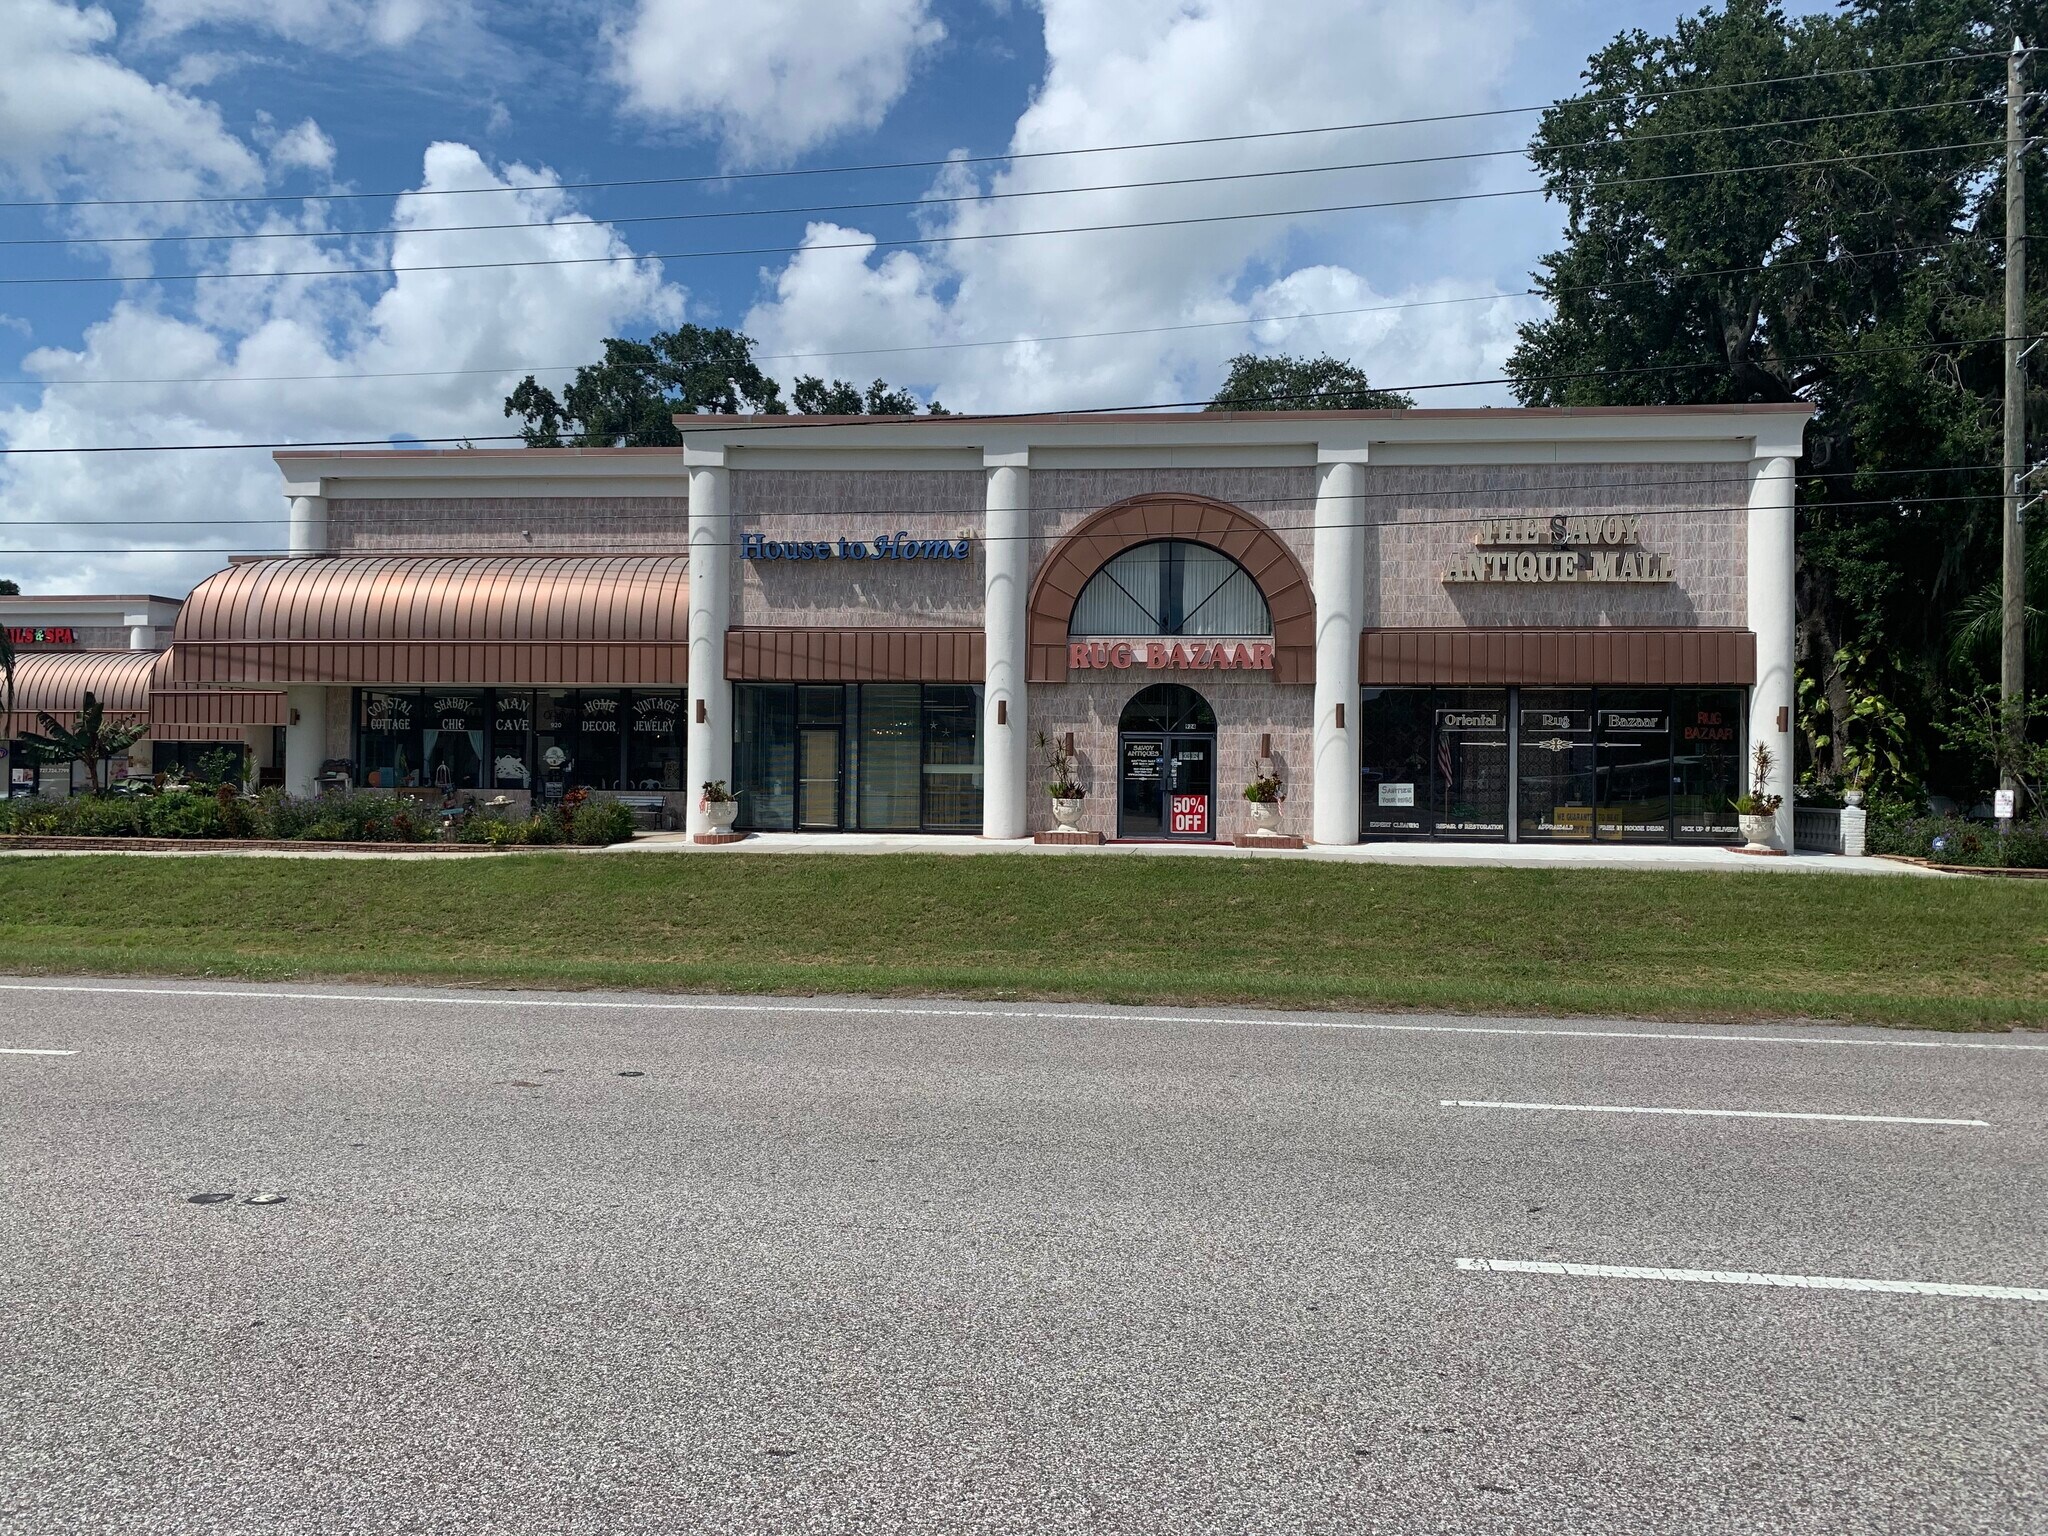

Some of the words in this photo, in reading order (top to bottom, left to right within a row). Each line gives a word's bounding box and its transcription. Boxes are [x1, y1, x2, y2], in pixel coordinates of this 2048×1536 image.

[1477, 515, 1540, 545] THE
[1550, 513, 1641, 546] SAVOY
[739, 533, 831, 561] House
[837, 536, 867, 561] to
[868, 530, 970, 562] Home
[1443, 551, 1579, 583] ANTIQUE
[1588, 551, 1677, 583] MALL
[45, 627, 74, 644] SPA
[1069, 642, 1133, 669] RUG
[1145, 642, 1274, 670] BAZAAR
[367, 697, 413, 717] COASTAL
[433, 696, 474, 713] SHABBY
[496, 697, 531, 712] MAN
[583, 698, 617, 714] HOME
[632, 697, 680, 715] VINTAGE
[370, 718, 411, 730] COTTAGE
[441, 718, 465, 730] CHIC
[495, 717, 530, 731] CAVE
[550, 721, 562, 729] 920
[633, 719, 676, 732] JEWELRY
[1444, 714, 1497, 726] Oriental
[1542, 714, 1571, 729] Rug
[1608, 714, 1659, 727] Bazaar
[1697, 711, 1722, 725] RUG
[581, 720, 616, 732] DECOR
[1684, 726, 1733, 741] BAZAAR
[1173, 796, 1205, 814] 50%
[1175, 813, 1202, 831] OFF
